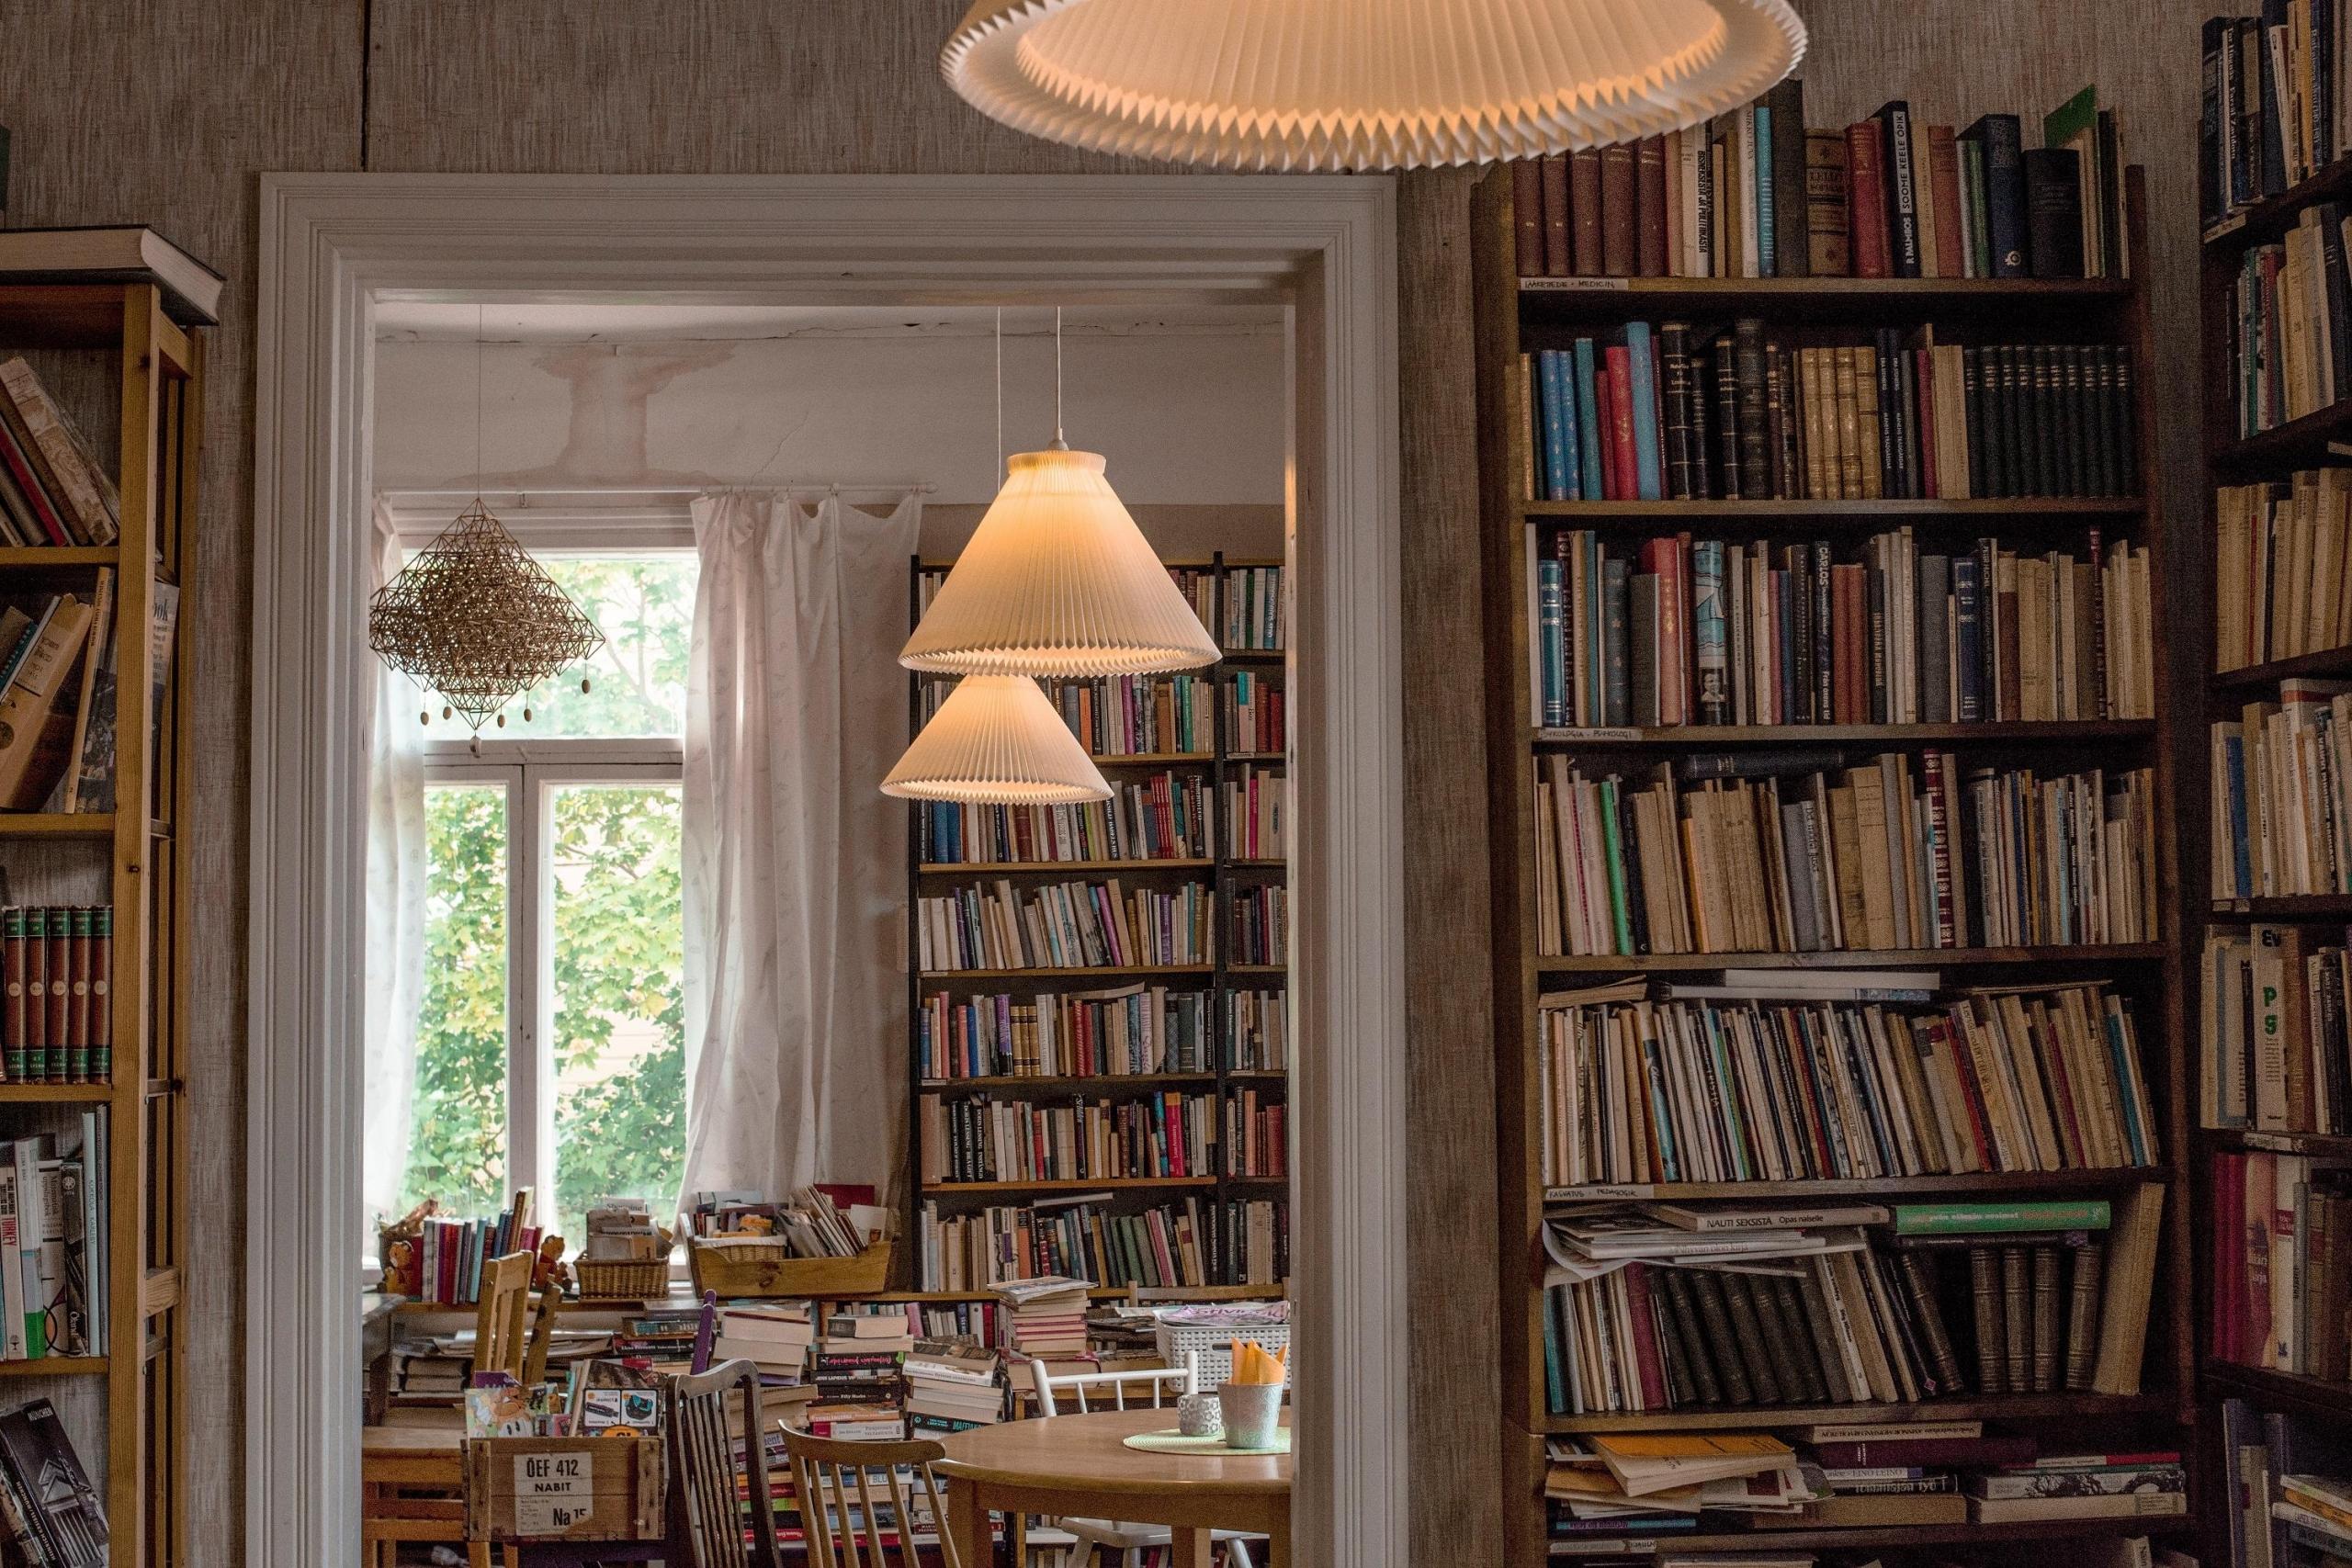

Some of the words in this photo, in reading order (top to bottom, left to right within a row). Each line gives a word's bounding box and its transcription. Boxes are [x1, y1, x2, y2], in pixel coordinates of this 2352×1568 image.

[1897, 141, 1907, 170] KEELE
[1901, 173, 1910, 209] SOOME
[1819, 547, 1828, 586] CARLOS
[977, 1126, 985, 1149] LESSING
[41, 1175, 51, 1217] uppslagsbok
[49, 1175, 59, 1214] Matematisk
[2, 1216, 17, 1247] TURKEY
[1706, 1219, 1734, 1228] NAUTI
[1736, 1216, 1773, 1227] SEKSISTÄ
[1779, 1216, 1798, 1225] Opas
[1798, 1215, 1824, 1224] naiselle
[69, 1311, 80, 1337] Öland
[28, 1407, 54, 1423] MÜNCHEN
[526, 1457, 550, 1478] ÖEF
[557, 1459, 579, 1476] 412
[15, 1480, 33, 1509] MÜNCHEN
[535, 1483, 571, 1492] NABIT
[553, 1507, 571, 1526] Na
[40, 1532, 56, 1561] HEINRICH
